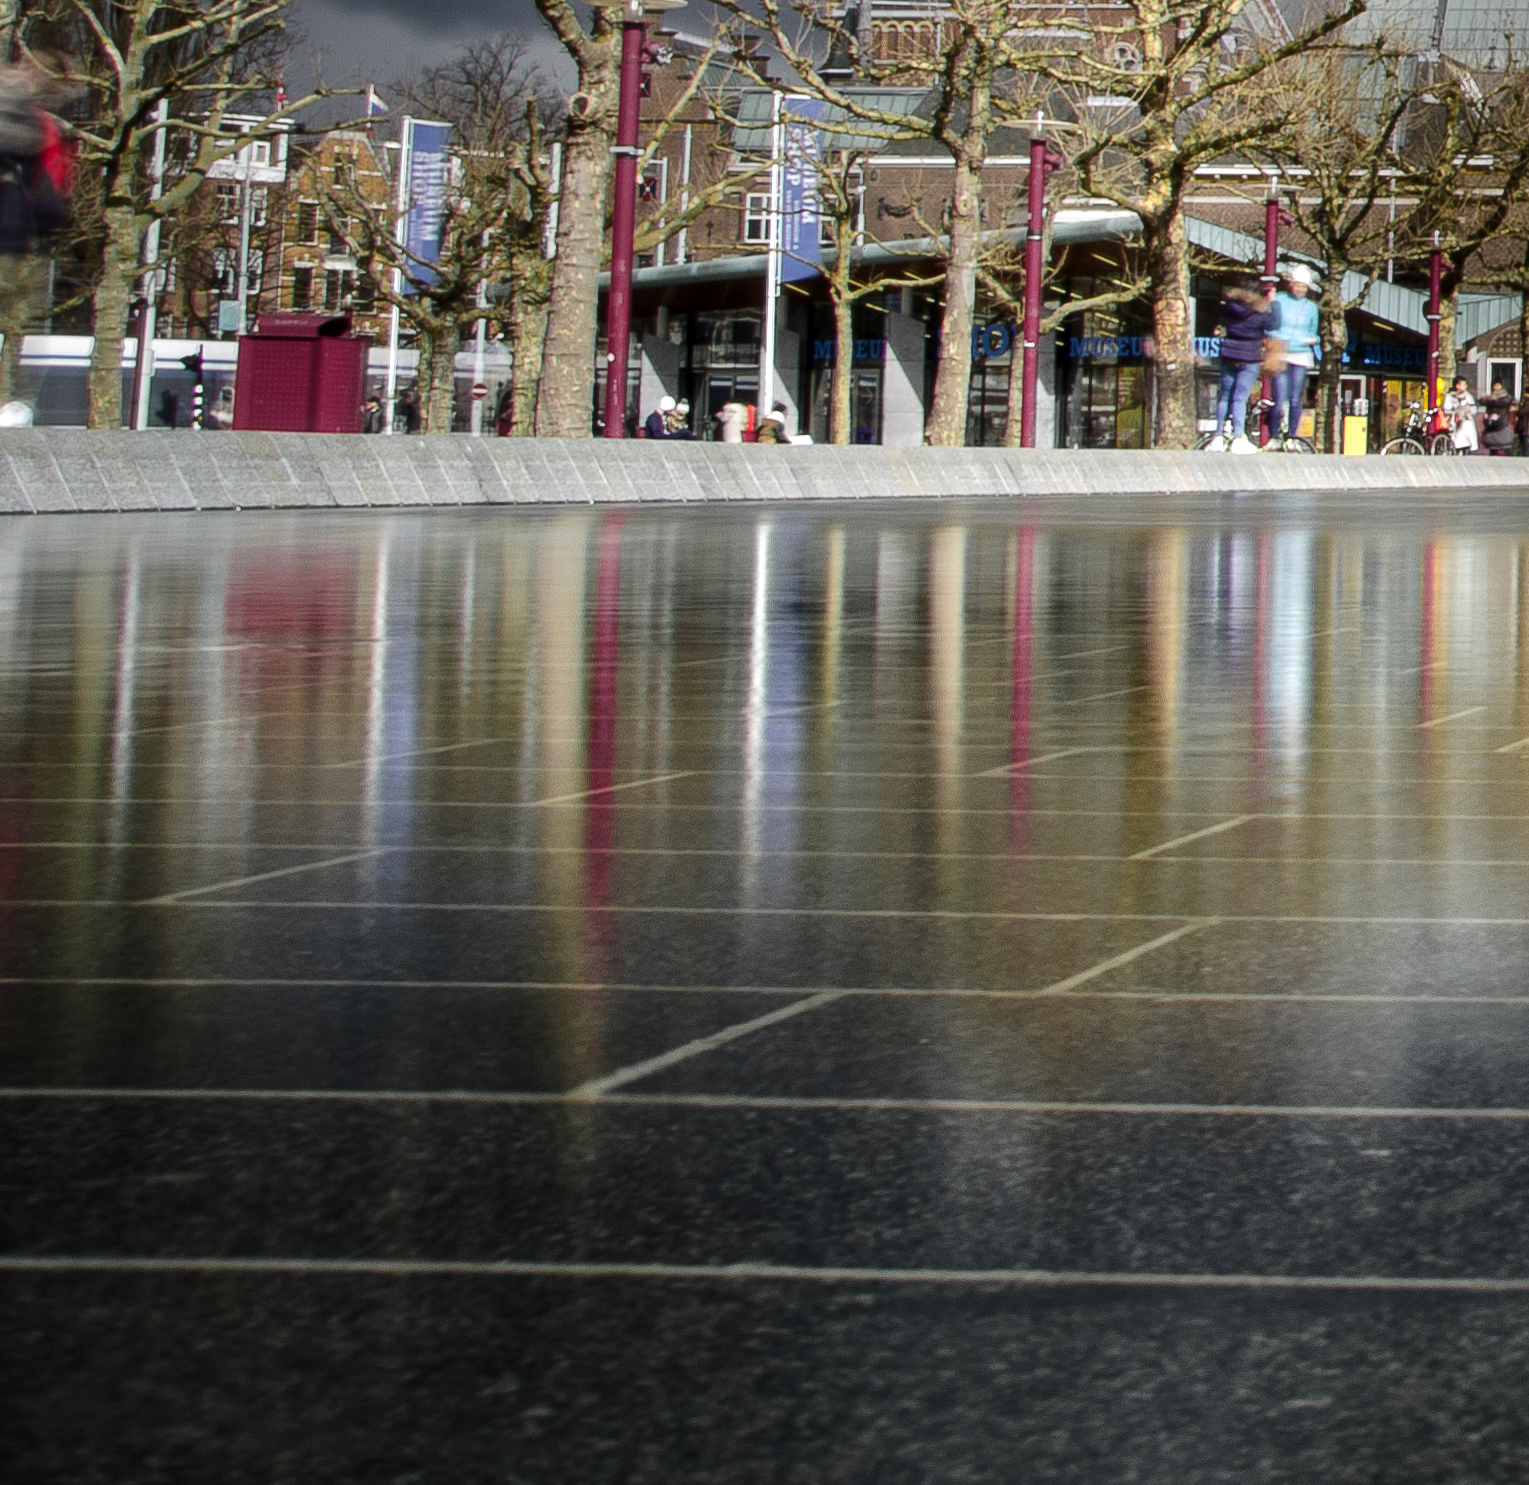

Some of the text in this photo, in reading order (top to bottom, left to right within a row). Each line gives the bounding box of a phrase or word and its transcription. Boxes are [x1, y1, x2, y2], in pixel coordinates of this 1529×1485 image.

[786, 127, 802, 185] SHOP
[1069, 337, 1148, 358] MUSEU
[1364, 345, 1429, 364] MUSEU
